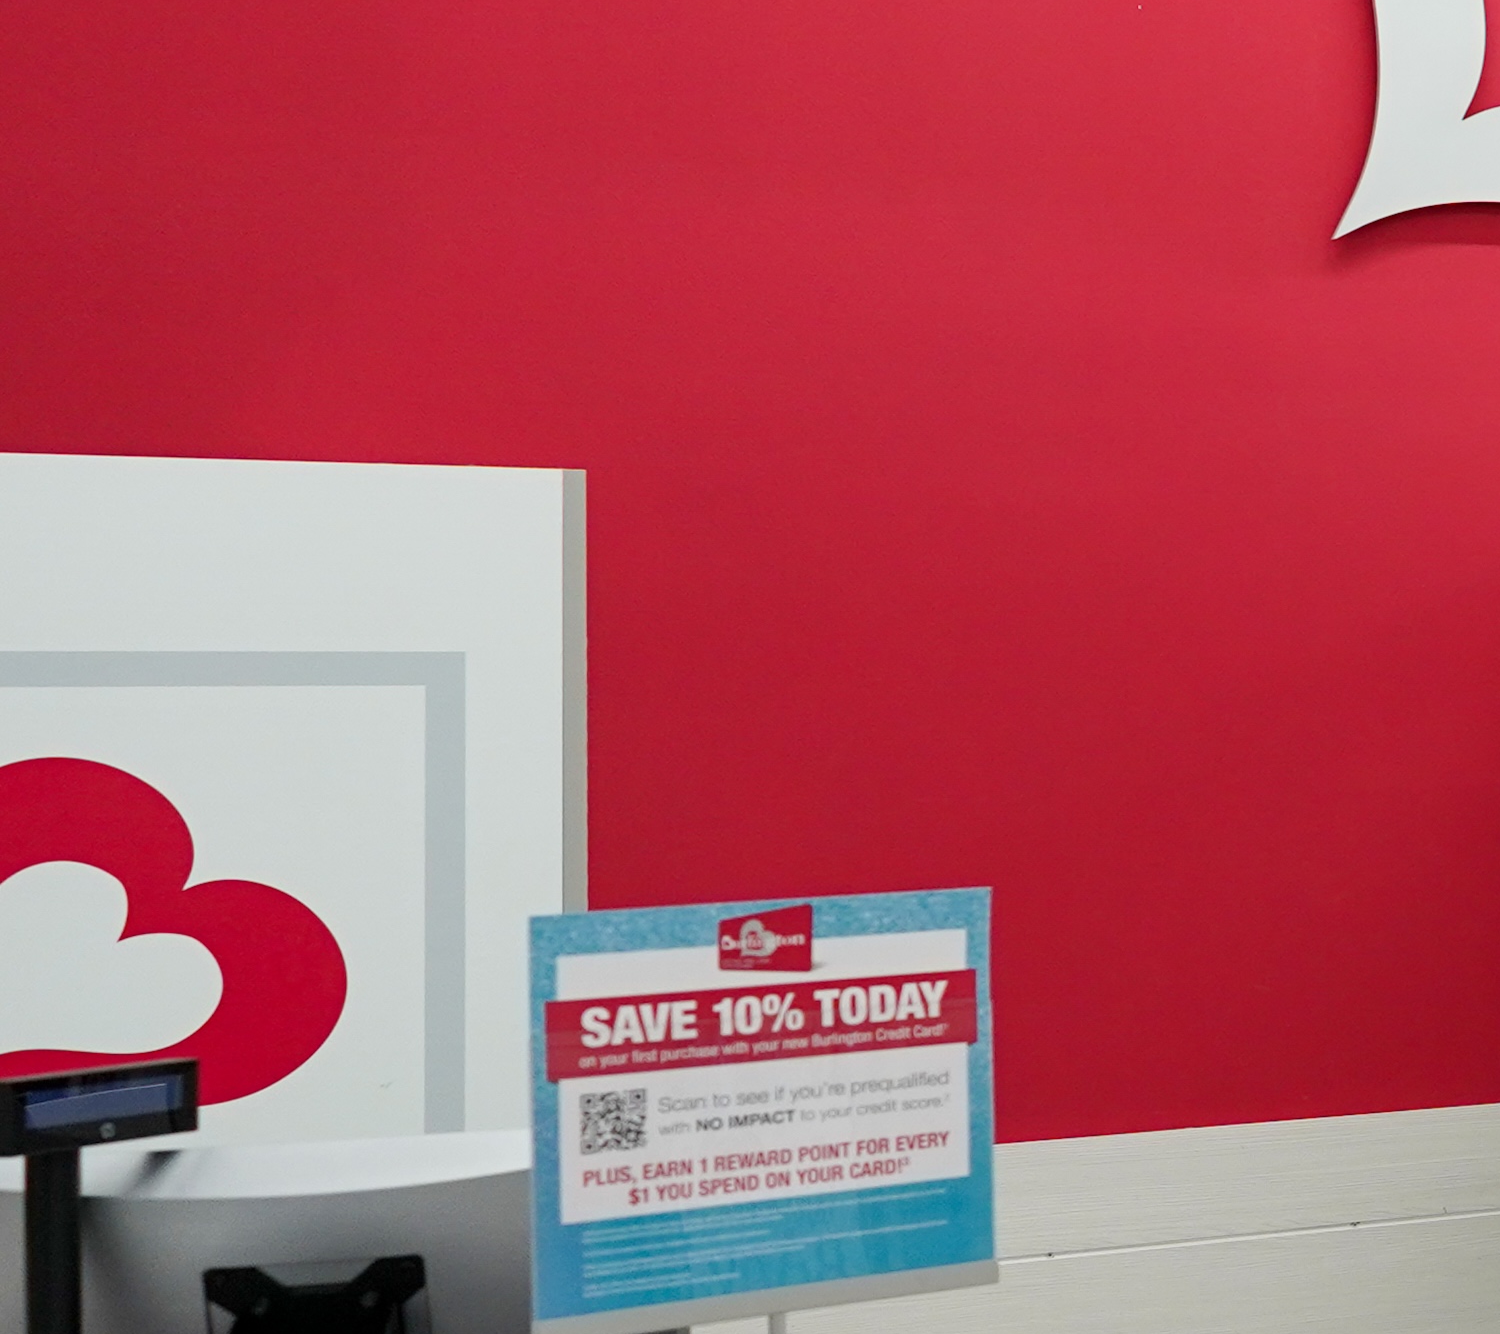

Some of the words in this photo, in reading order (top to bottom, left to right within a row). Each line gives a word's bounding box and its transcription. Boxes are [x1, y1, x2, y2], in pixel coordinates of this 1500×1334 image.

[580, 1000, 698, 1048] SAVE
[712, 993, 804, 1036] 10%
[814, 980, 949, 1027] TODAY
[599, 1053, 629, 1070] your
[632, 1049, 658, 1064] first
[660, 1046, 719, 1065] purchase
[721, 1042, 749, 1057] with
[752, 1041, 779, 1058] your
[811, 1031, 872, 1052] Burlington
[876, 1026, 910, 1043] Credit
[658, 1095, 708, 1113] Scan
[712, 1093, 730, 1109] to
[736, 1090, 769, 1105] see
[774, 1085, 786, 1101] if
[850, 1071, 950, 1098] prequalified
[659, 1120, 691, 1137] with
[696, 1117, 723, 1133] NO
[729, 1109, 795, 1129] IMPACT
[801, 1107, 816, 1121] to
[819, 1105, 852, 1122] your
[856, 1099, 897, 1116] credit
[583, 1166, 636, 1189] PLUS,
[643, 1159, 693, 1182] EARN
[700, 1159, 708, 1175] 1
[715, 1149, 792, 1172] REWARD
[798, 1143, 852, 1162] POINT
[857, 1139, 889, 1156] FOR
[896, 1131, 950, 1153] EVERY
[628, 1187, 649, 1207] $1
[657, 1182, 693, 1201] YOU
[699, 1174, 759, 1197] SPEND
[766, 1169, 791, 1190] ON
[796, 1164, 844, 1185] YOUR
